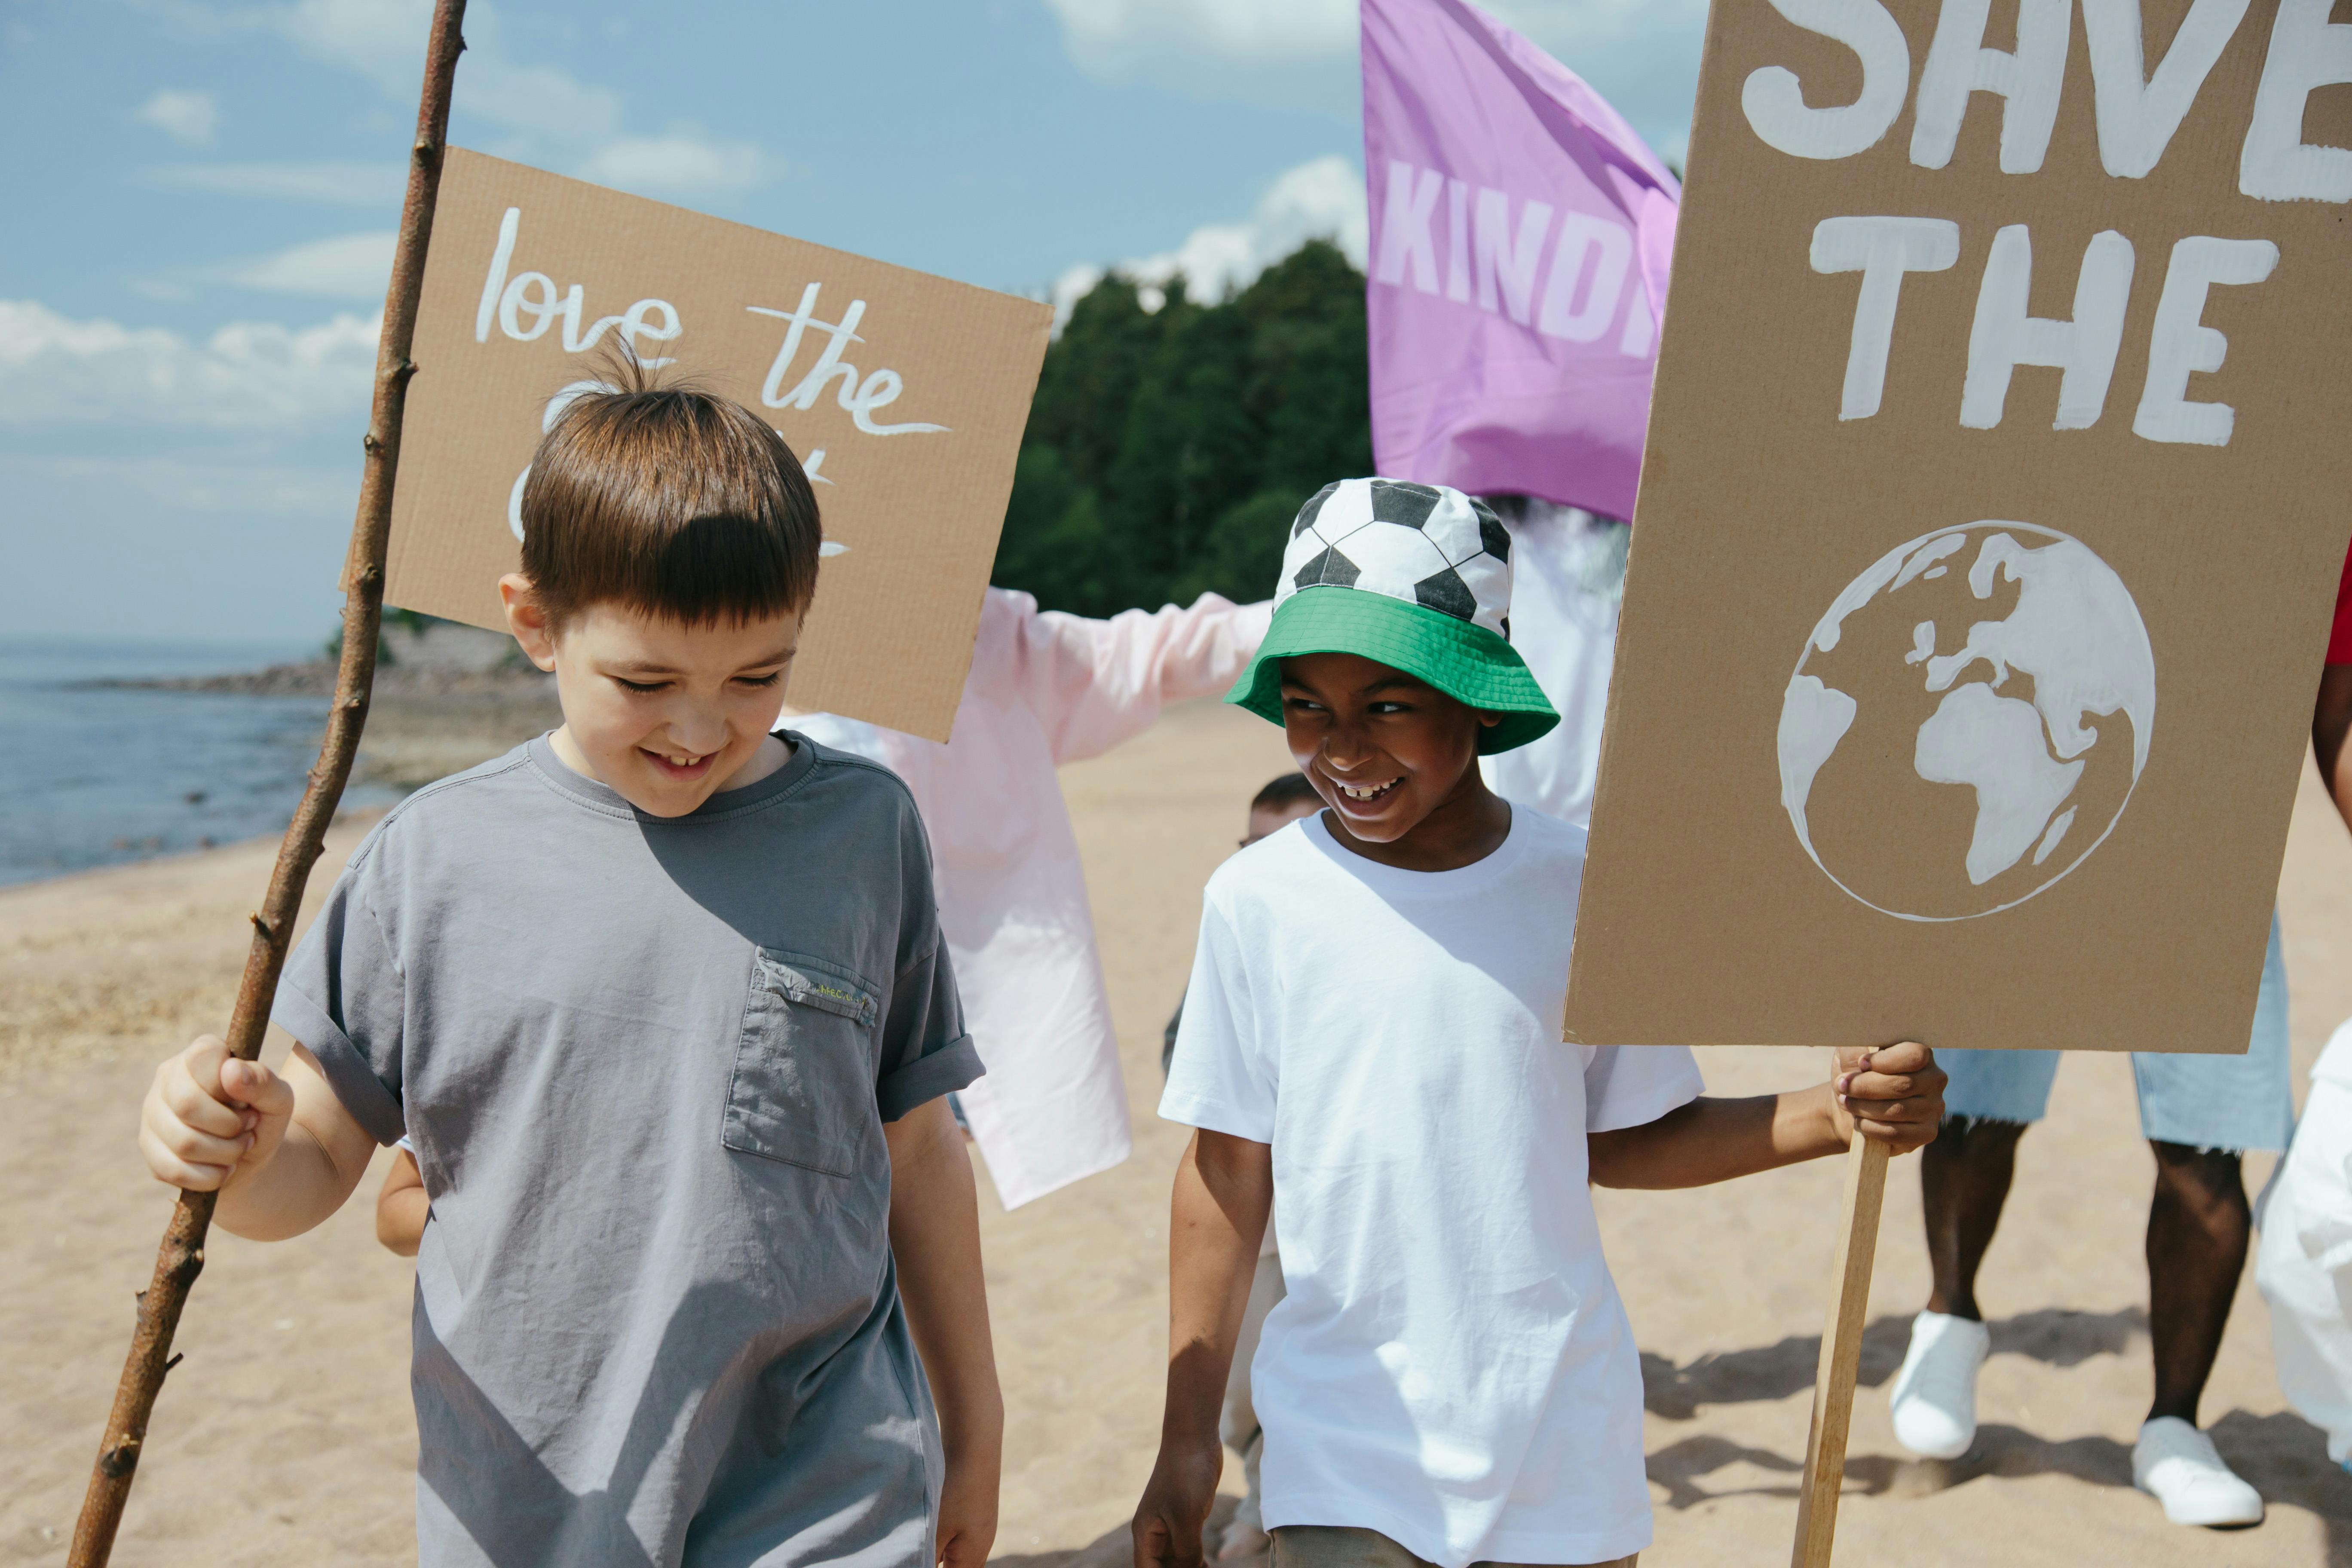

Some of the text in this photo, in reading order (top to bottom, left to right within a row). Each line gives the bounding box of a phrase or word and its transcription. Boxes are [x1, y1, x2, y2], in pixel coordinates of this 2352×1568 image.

[475, 206, 952, 435] love the
[1809, 215, 2280, 447] THE
